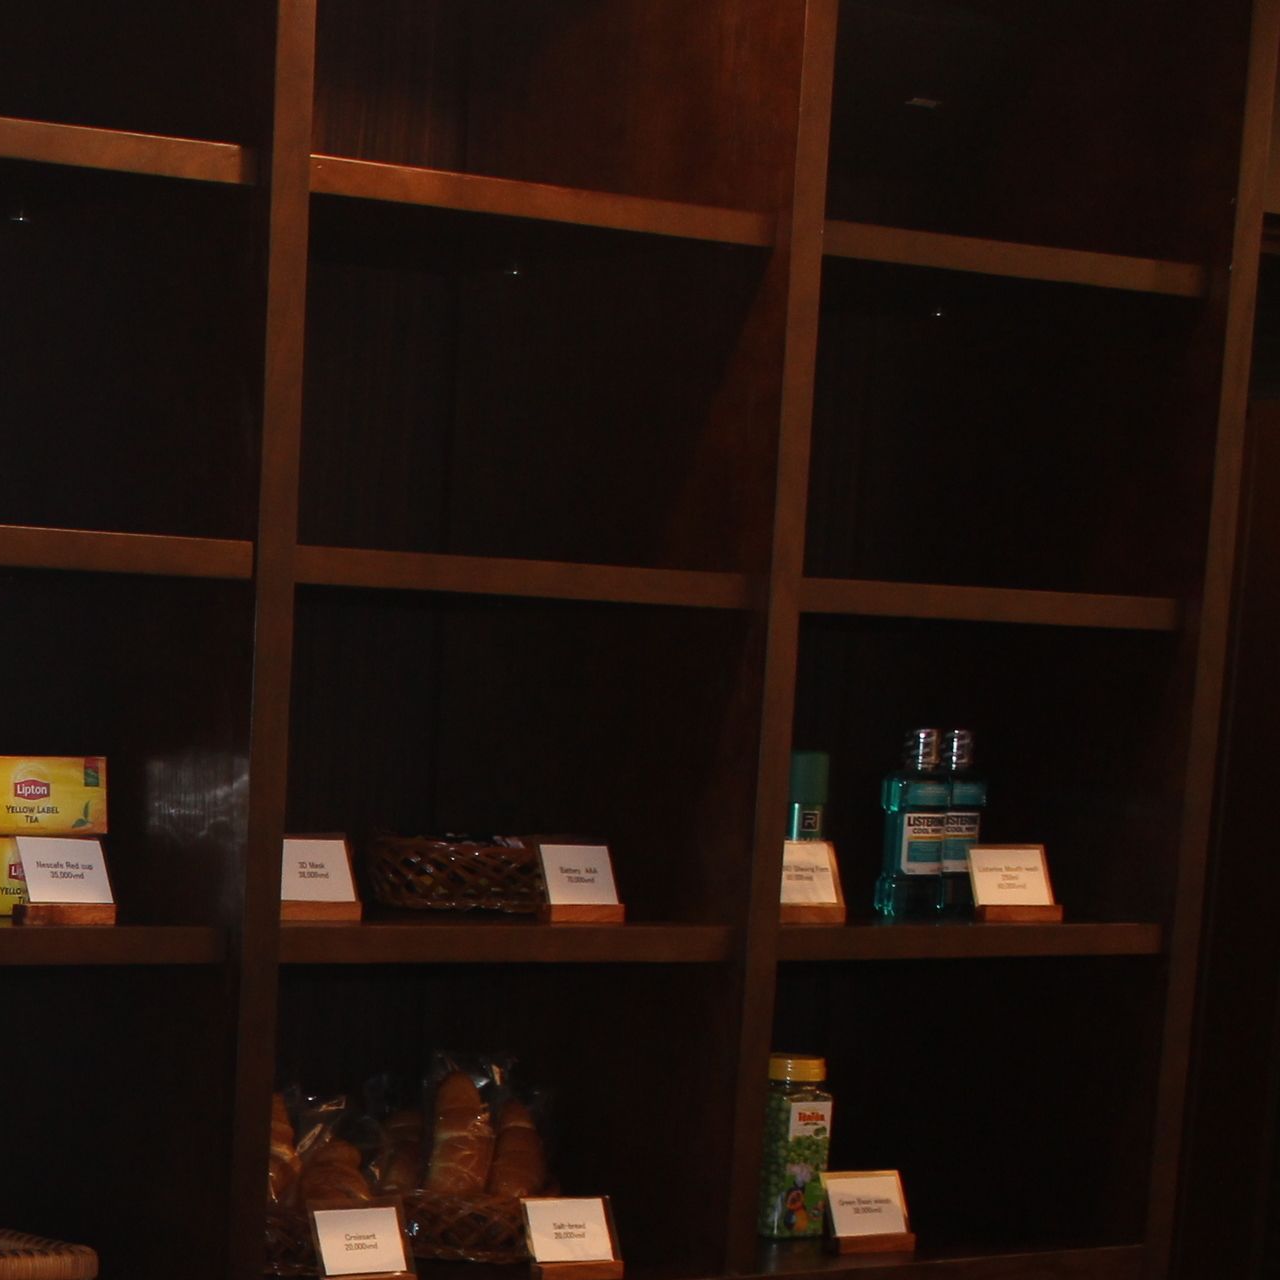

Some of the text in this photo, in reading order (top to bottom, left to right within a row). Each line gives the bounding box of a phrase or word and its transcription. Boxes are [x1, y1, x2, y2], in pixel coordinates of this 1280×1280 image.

[16, 783, 48, 796] Lipton
[5, 805, 60, 814] YELLOW LABEL
[25, 815, 40, 824] TEA
[804, 815, 816, 829] R
[344, 1232, 376, 1242] Croissant
